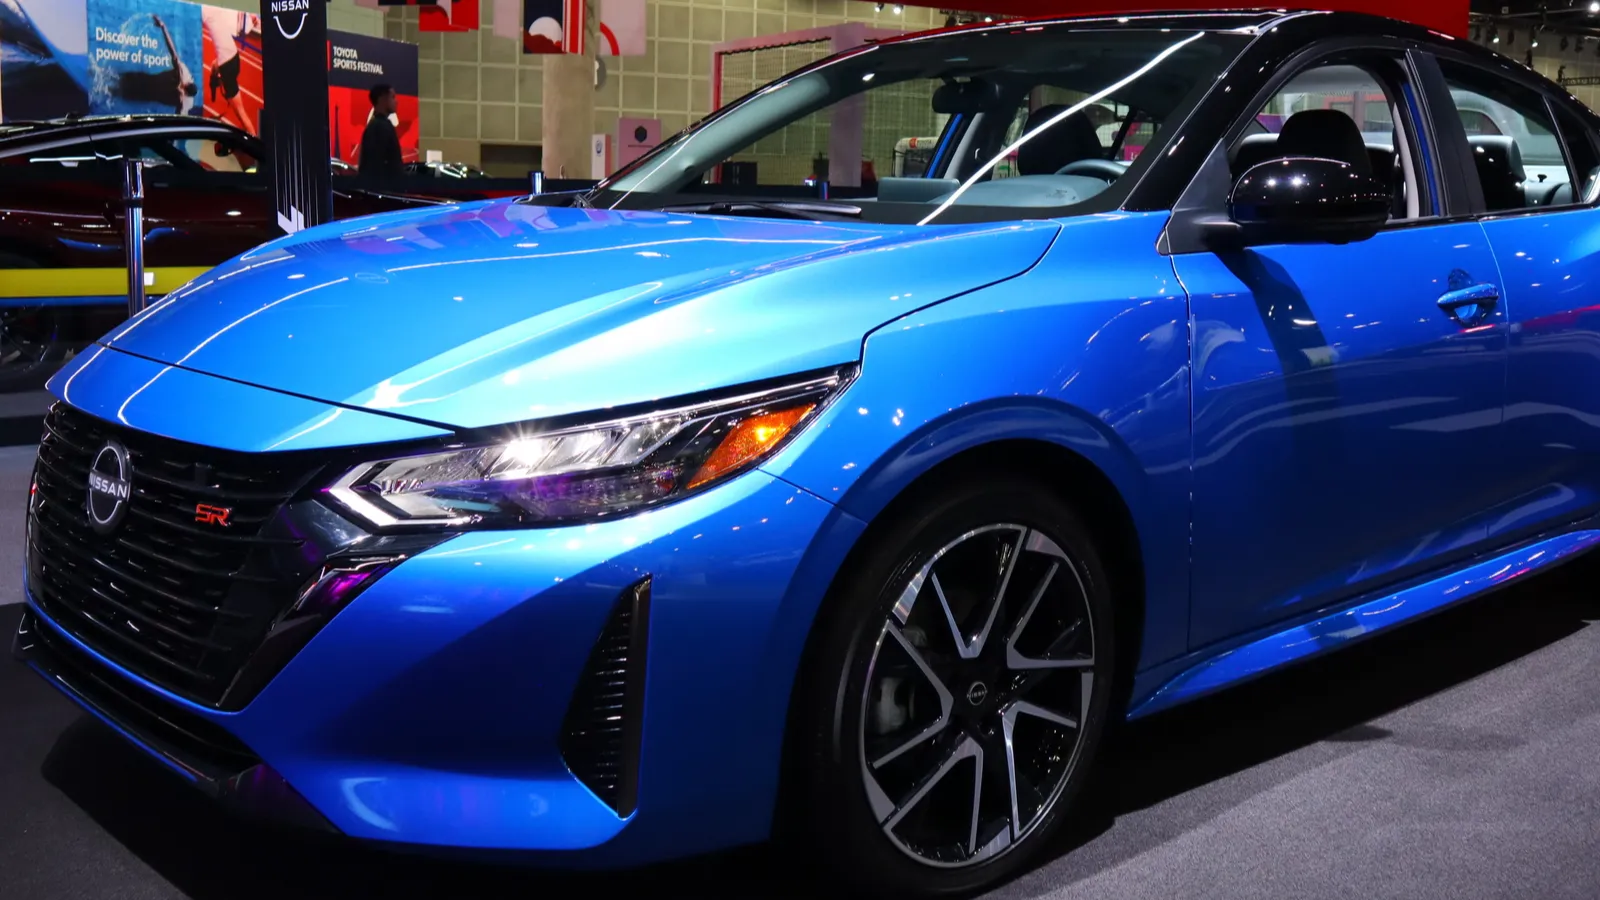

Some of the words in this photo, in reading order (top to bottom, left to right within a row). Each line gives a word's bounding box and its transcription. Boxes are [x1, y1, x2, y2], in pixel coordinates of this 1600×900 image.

[271, 0, 309, 12] NISSAN
[95, 26, 140, 46] Discover
[141, 33, 158, 49] the
[96, 48, 129, 62] power
[131, 49, 142, 63] of
[143, 53, 170, 68] sport
[333, 45, 358, 60] TOYOTA
[333, 57, 357, 71] SPORTS
[357, 60, 384, 75] FESTIVAL
[88, 471, 128, 498] NISSAN
[194, 503, 232, 526] SR
